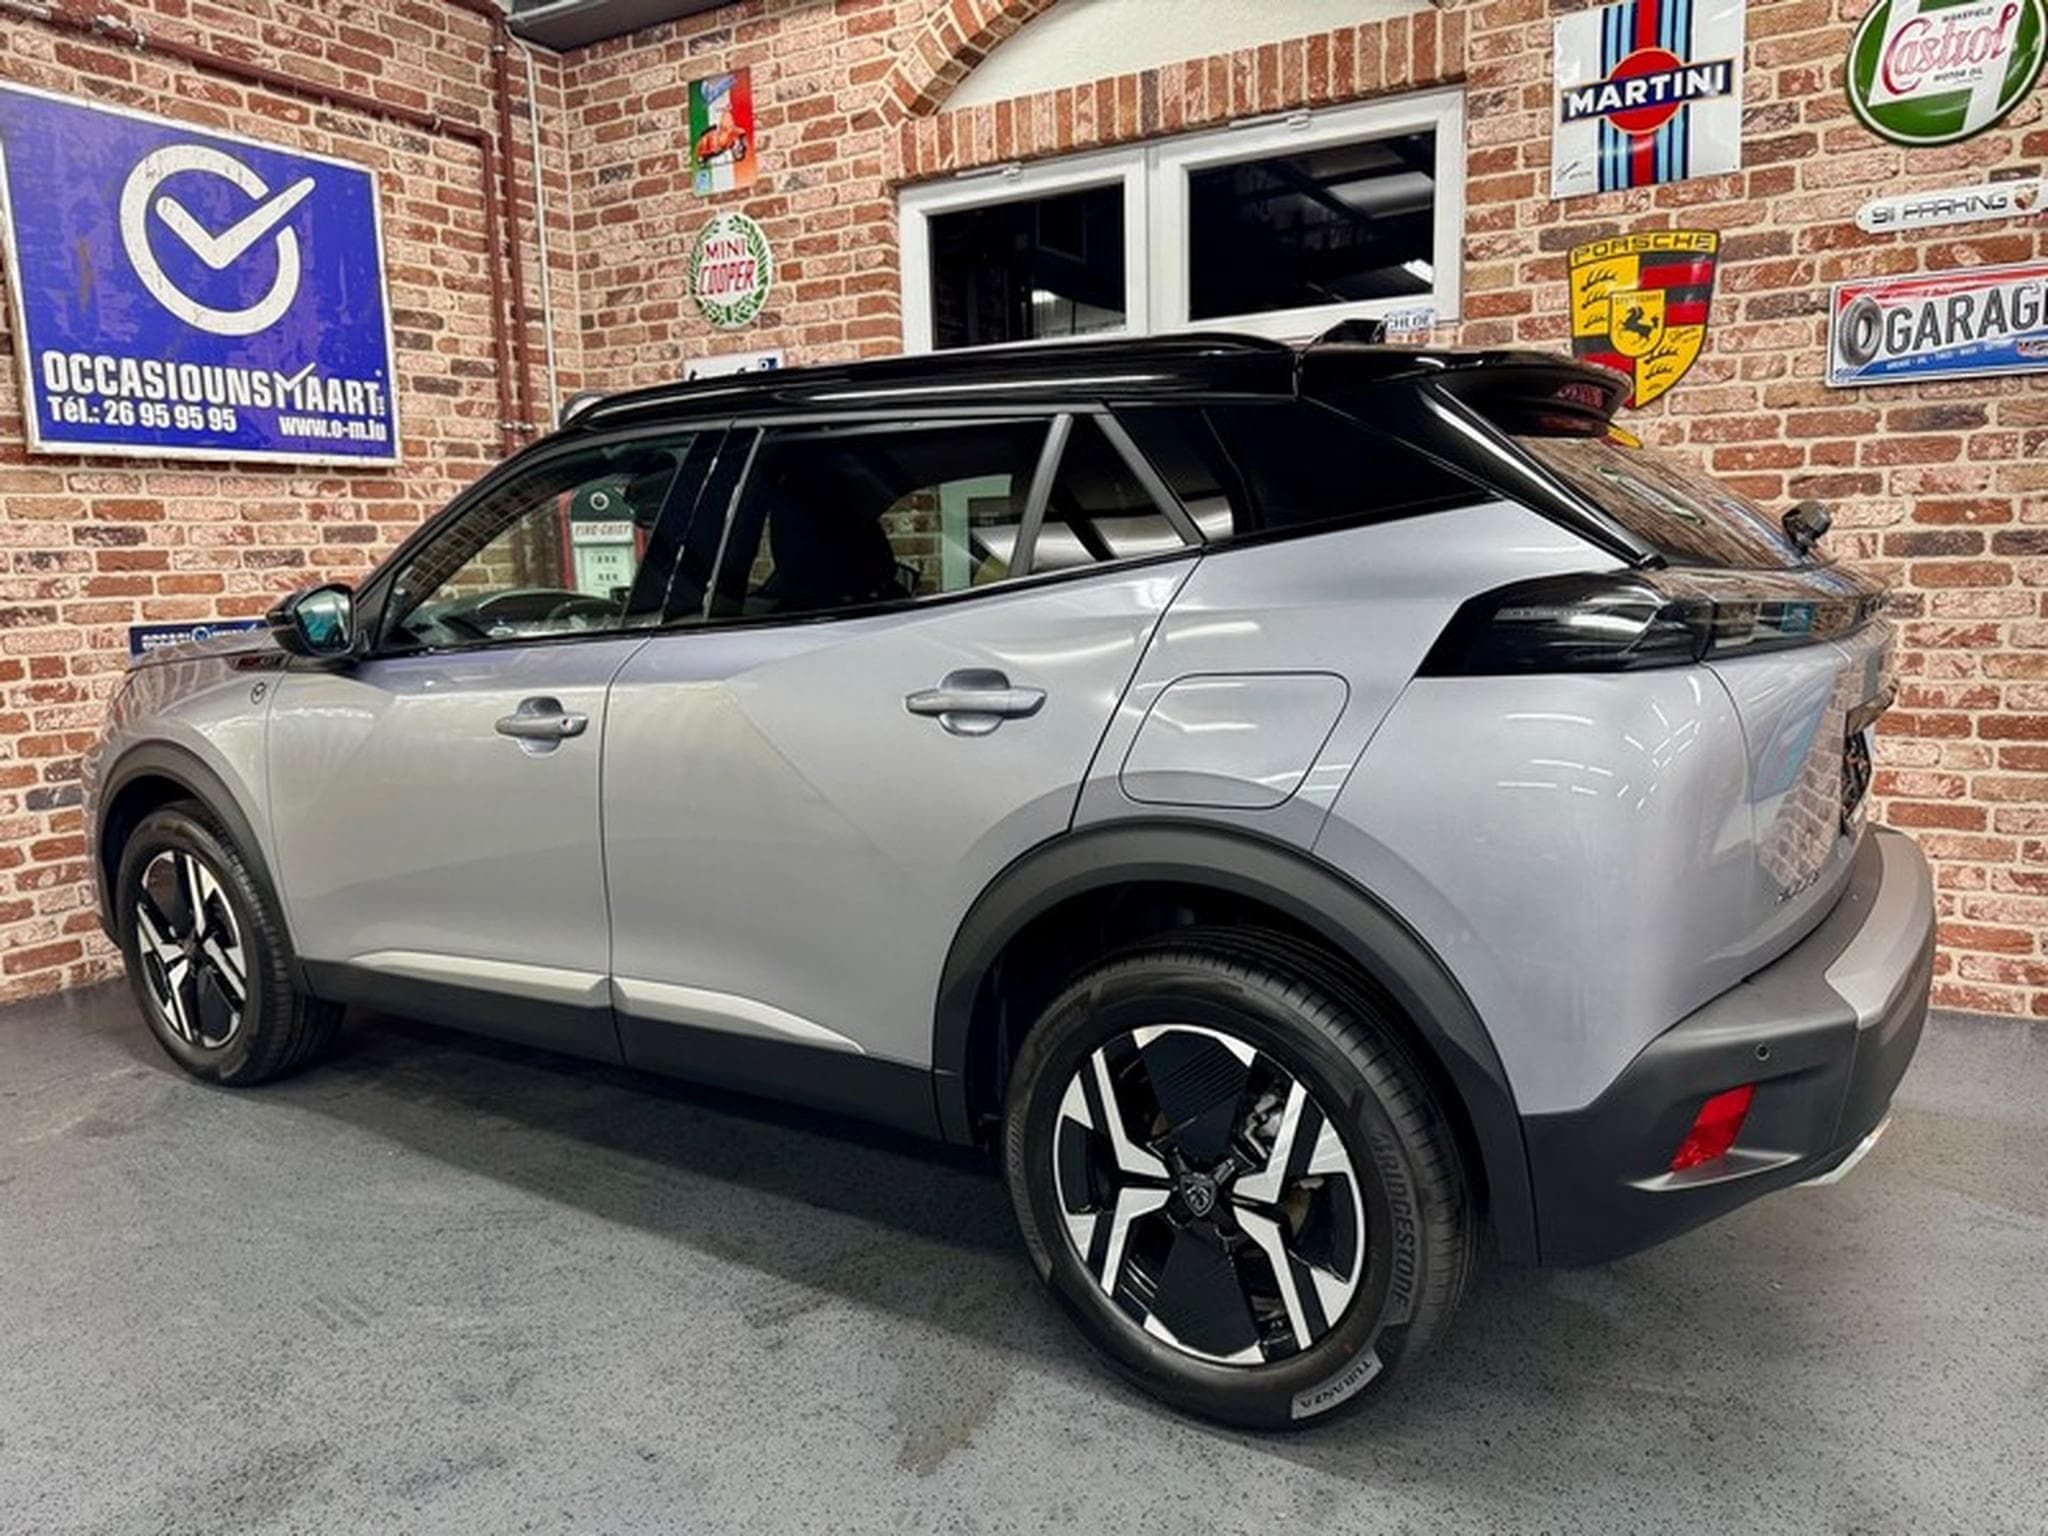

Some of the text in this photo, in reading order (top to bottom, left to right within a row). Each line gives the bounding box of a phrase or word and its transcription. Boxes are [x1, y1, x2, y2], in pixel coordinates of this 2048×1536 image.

[1882, 3, 2018, 96] Castrol
[1568, 64, 1725, 118] MARTINI
[1902, 191, 2008, 221] PARKING
[705, 239, 747, 261] MINI
[1574, 233, 1712, 265] PORSCHE
[698, 260, 756, 296] COOPER
[1884, 281, 2048, 356] GARAG
[48, 395, 237, 433] Tél.: 26 95 95 95
[279, 415, 387, 442] www.o-m.lu
